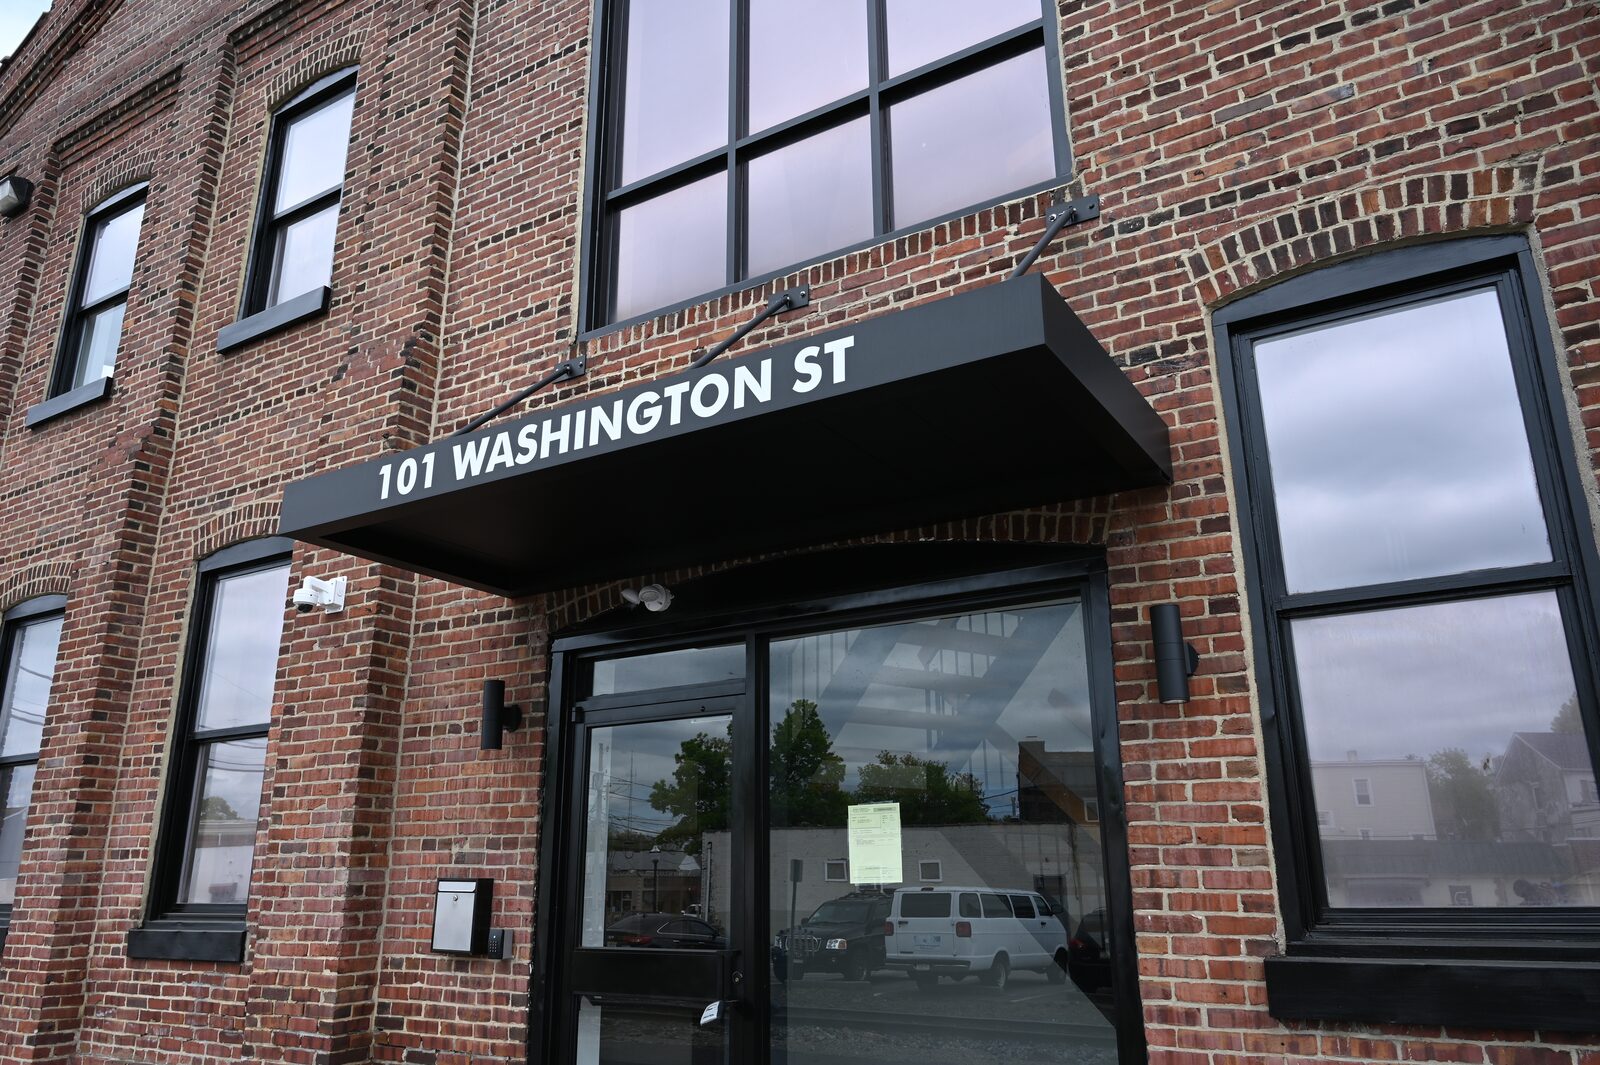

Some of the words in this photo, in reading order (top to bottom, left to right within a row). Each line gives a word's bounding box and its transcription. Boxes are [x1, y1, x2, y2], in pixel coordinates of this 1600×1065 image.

[378, 452, 436, 500] 101
[452, 358, 772, 481] WASHINGTON
[792, 335, 855, 394] ST
